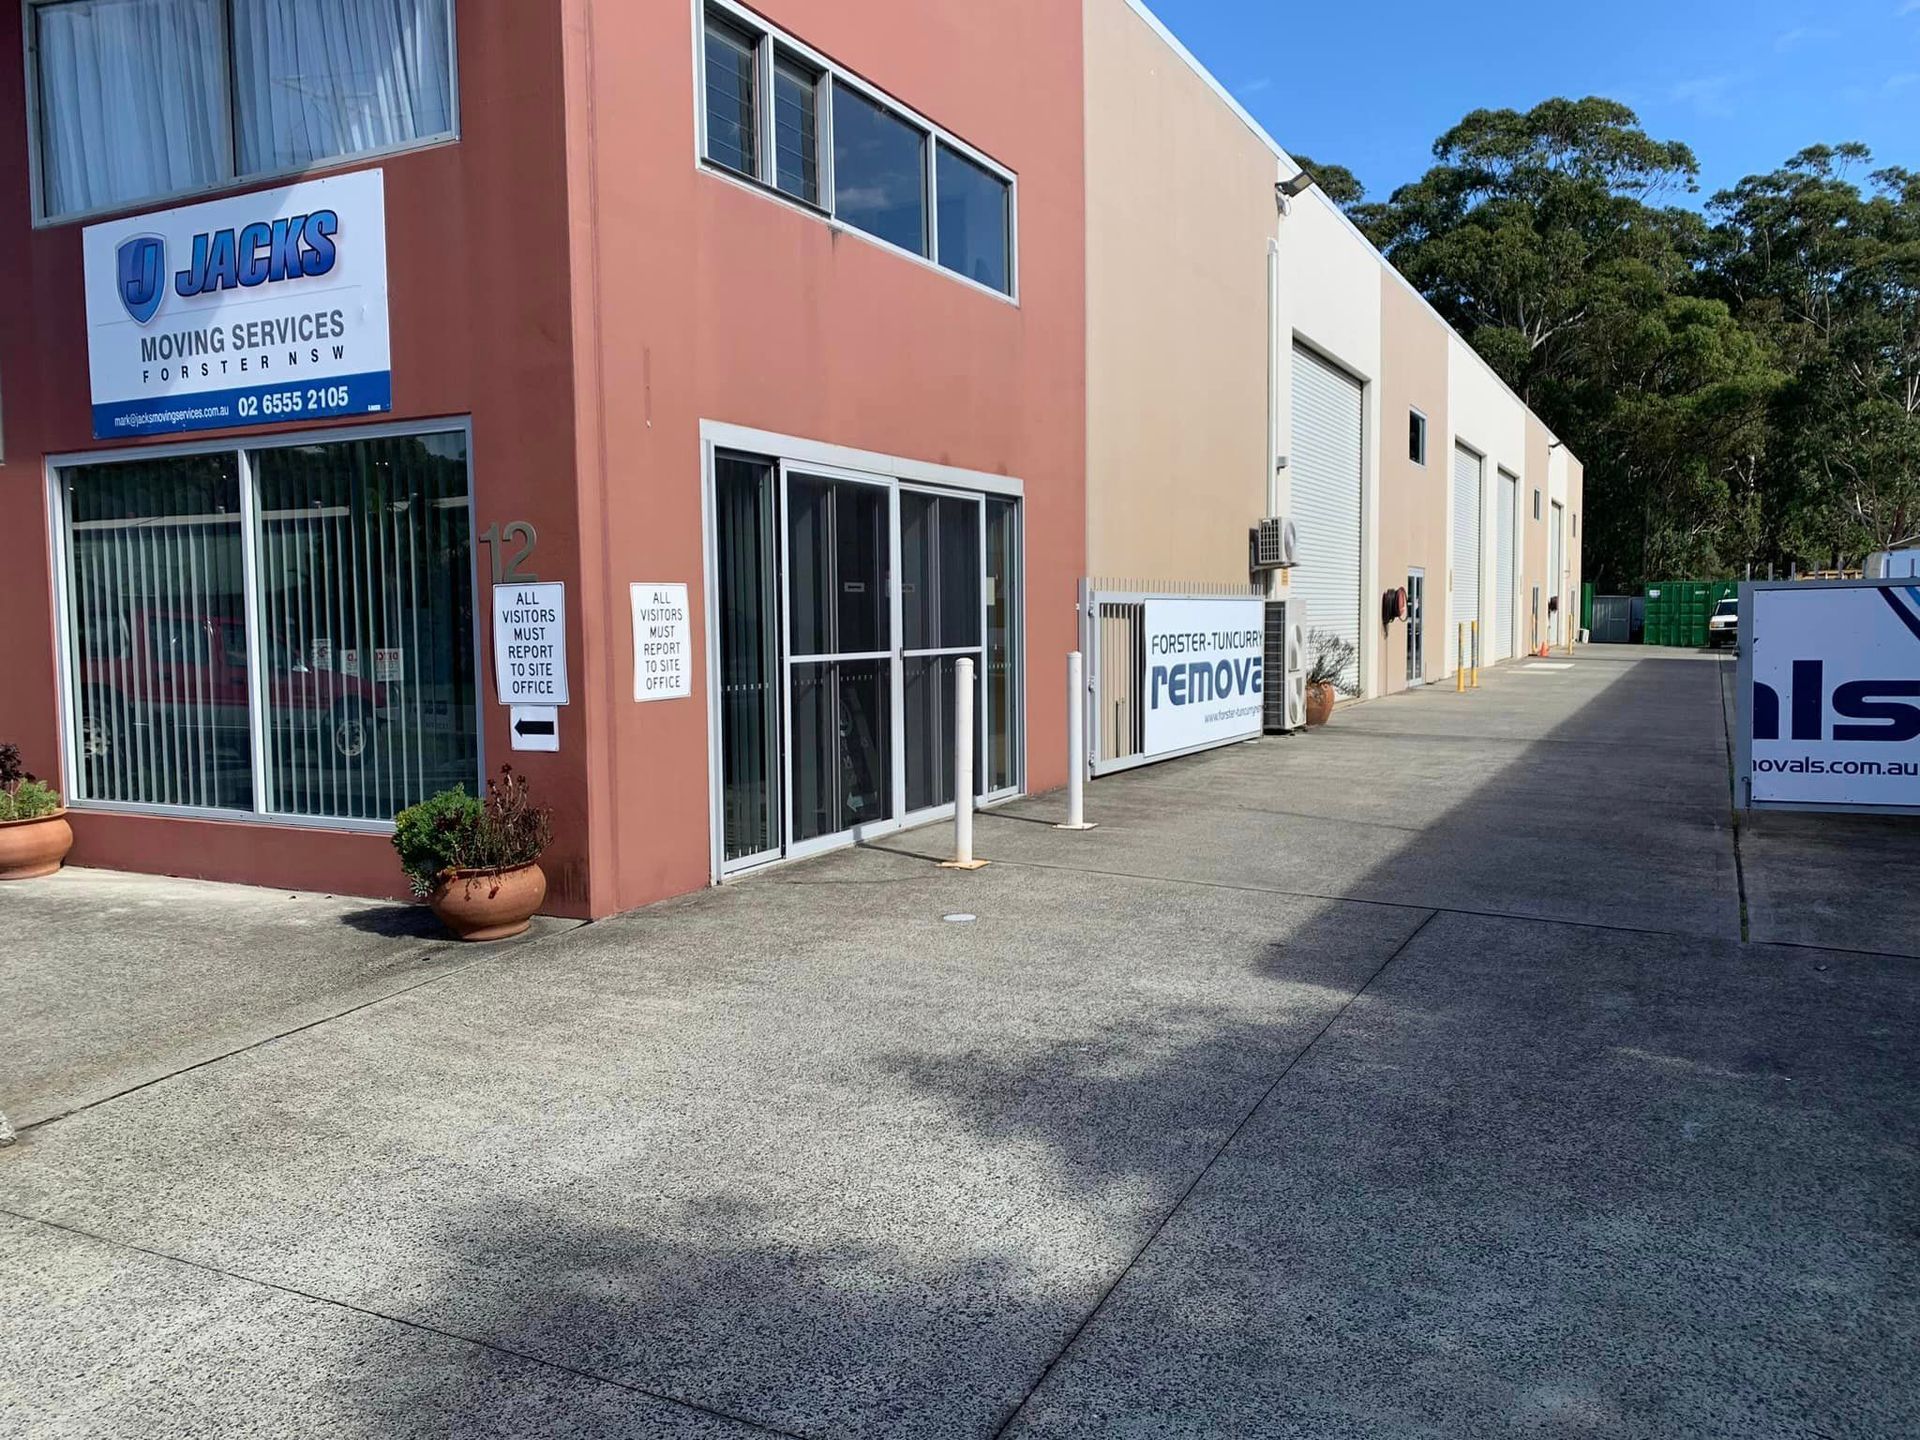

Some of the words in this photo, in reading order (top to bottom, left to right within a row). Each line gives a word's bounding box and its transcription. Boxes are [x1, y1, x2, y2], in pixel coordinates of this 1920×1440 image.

[174, 209, 338, 297] JACKS
[140, 327, 225, 363] MOVING
[231, 309, 345, 351] SERVICES
[143, 355, 269, 383] FORSTER
[114, 404, 229, 427] mark@jacksmovingservices.com.au
[238, 396, 258, 418] 02
[262, 390, 302, 414] 6555
[307, 385, 349, 410] 2105
[479, 521, 538, 583] 12
[516, 592, 539, 605] ALL
[652, 592, 671, 604] ALL
[502, 609, 556, 623] VISITORS
[640, 608, 683, 622] VISITORS
[514, 627, 546, 641] MUST
[649, 625, 675, 638] MUST
[643, 642, 681, 656] REPORT
[1151, 630, 1263, 655] FORSTER-TUNCURRY
[508, 645, 554, 659] REPORT
[510, 663, 525, 676] TO
[528, 662, 553, 676] SITE
[646, 660, 658, 673] TO
[660, 658, 681, 672] SITE
[512, 680, 554, 694] OFFICE
[646, 675, 681, 691] OFFICE
